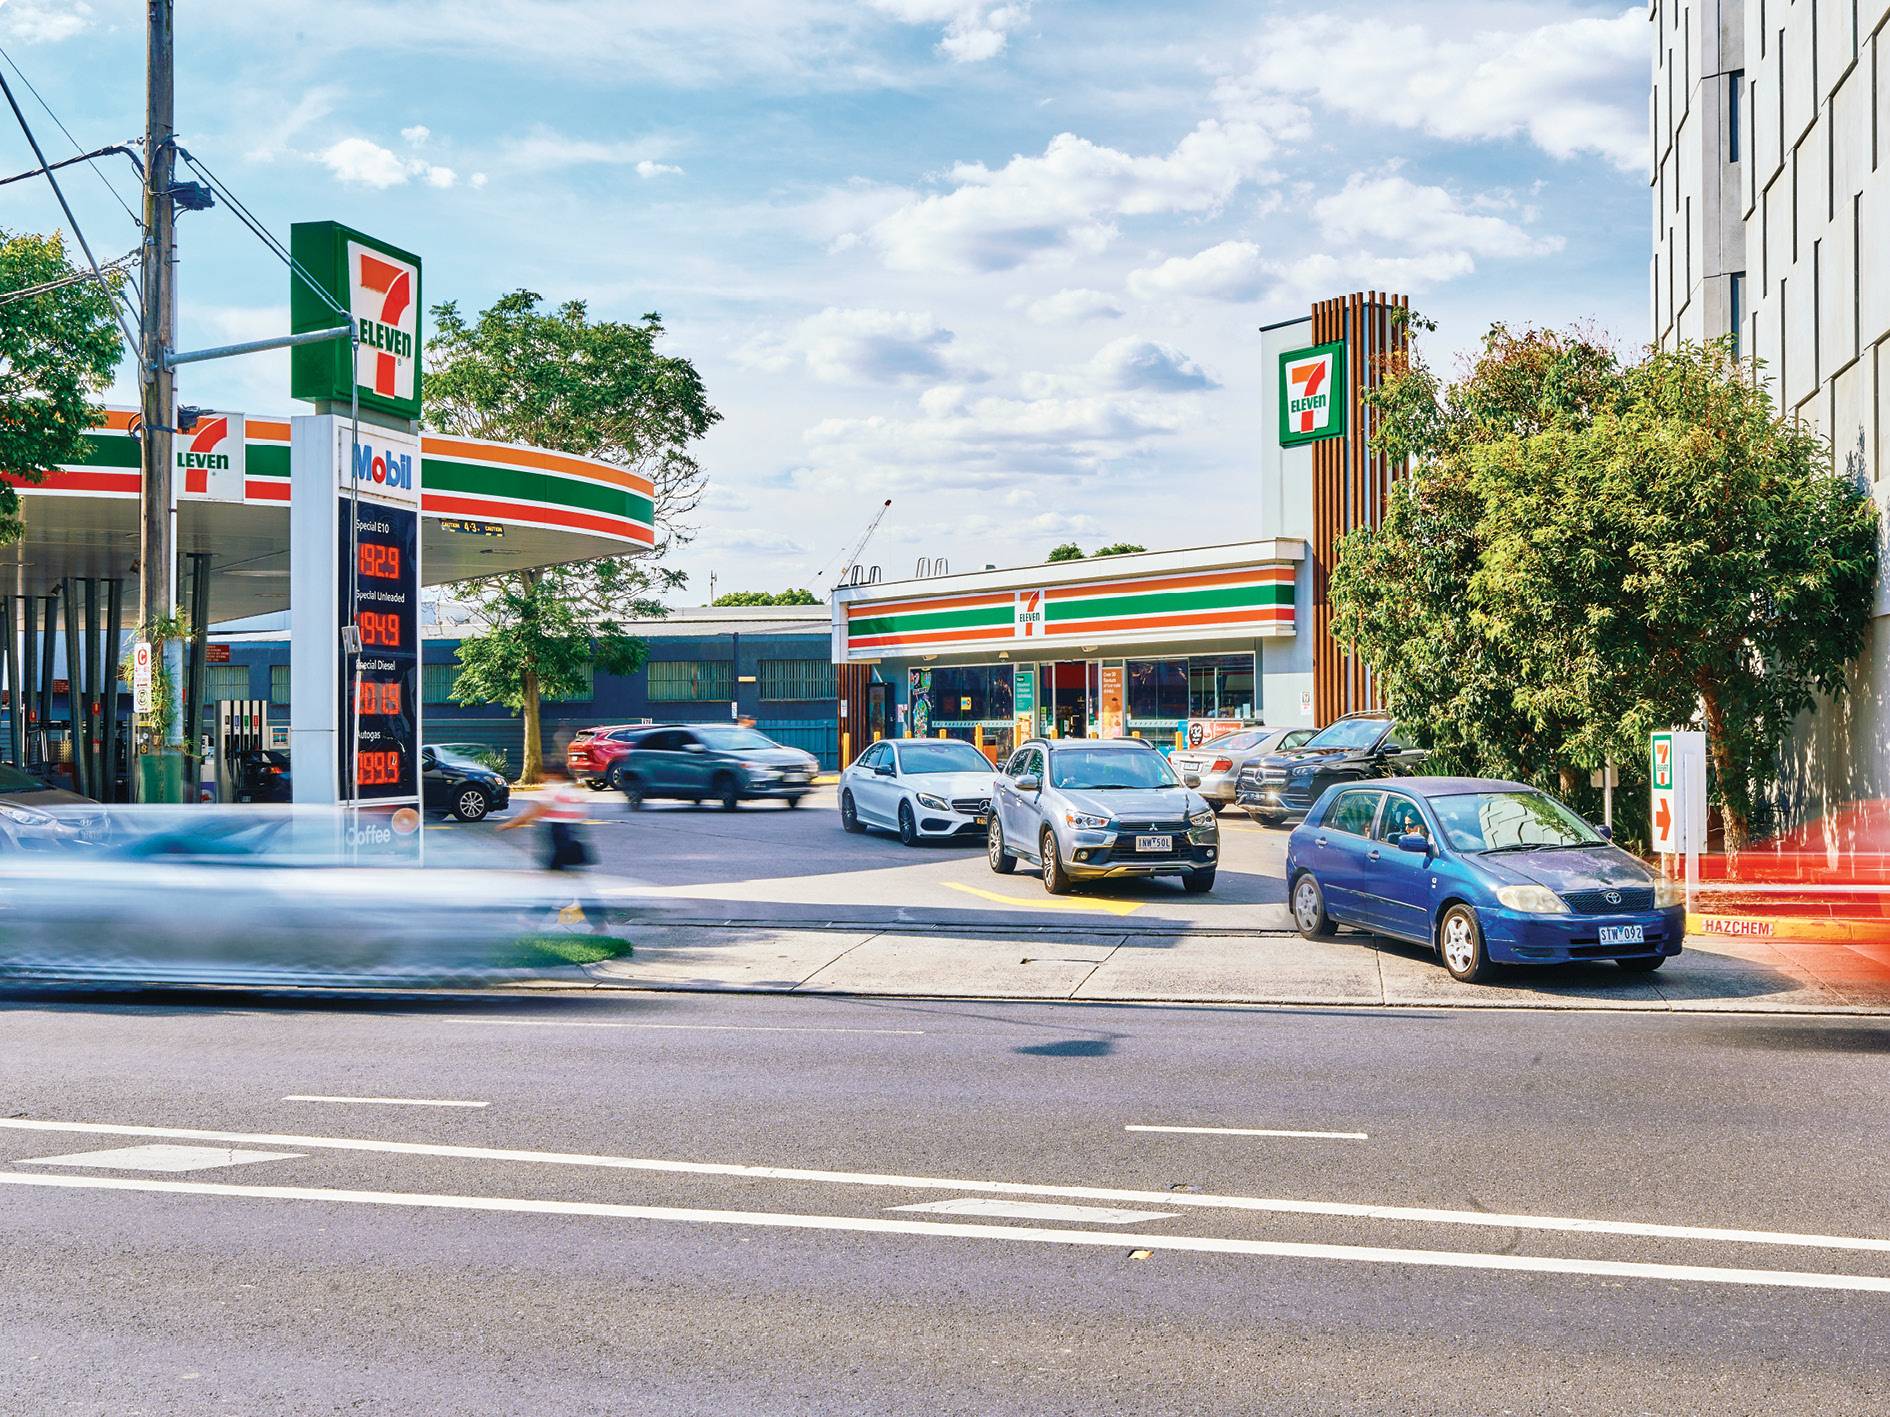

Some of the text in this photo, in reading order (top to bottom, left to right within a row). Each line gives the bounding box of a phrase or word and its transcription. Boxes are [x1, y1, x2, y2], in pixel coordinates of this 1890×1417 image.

[177, 452, 229, 470] LEVEn
[352, 443, 412, 490] Mobil
[356, 519, 390, 534] Special E10
[360, 543, 399, 579] 192.9
[356, 588, 405, 604] Special Unleaded
[359, 611, 399, 647] 194.9
[356, 659, 396, 671] pecial Diesel
[357, 751, 399, 785] 199.9
[345, 823, 392, 846] Coffee
[1600, 926, 1642, 941] STW 092
[1705, 919, 1770, 936] HAZCHEM
